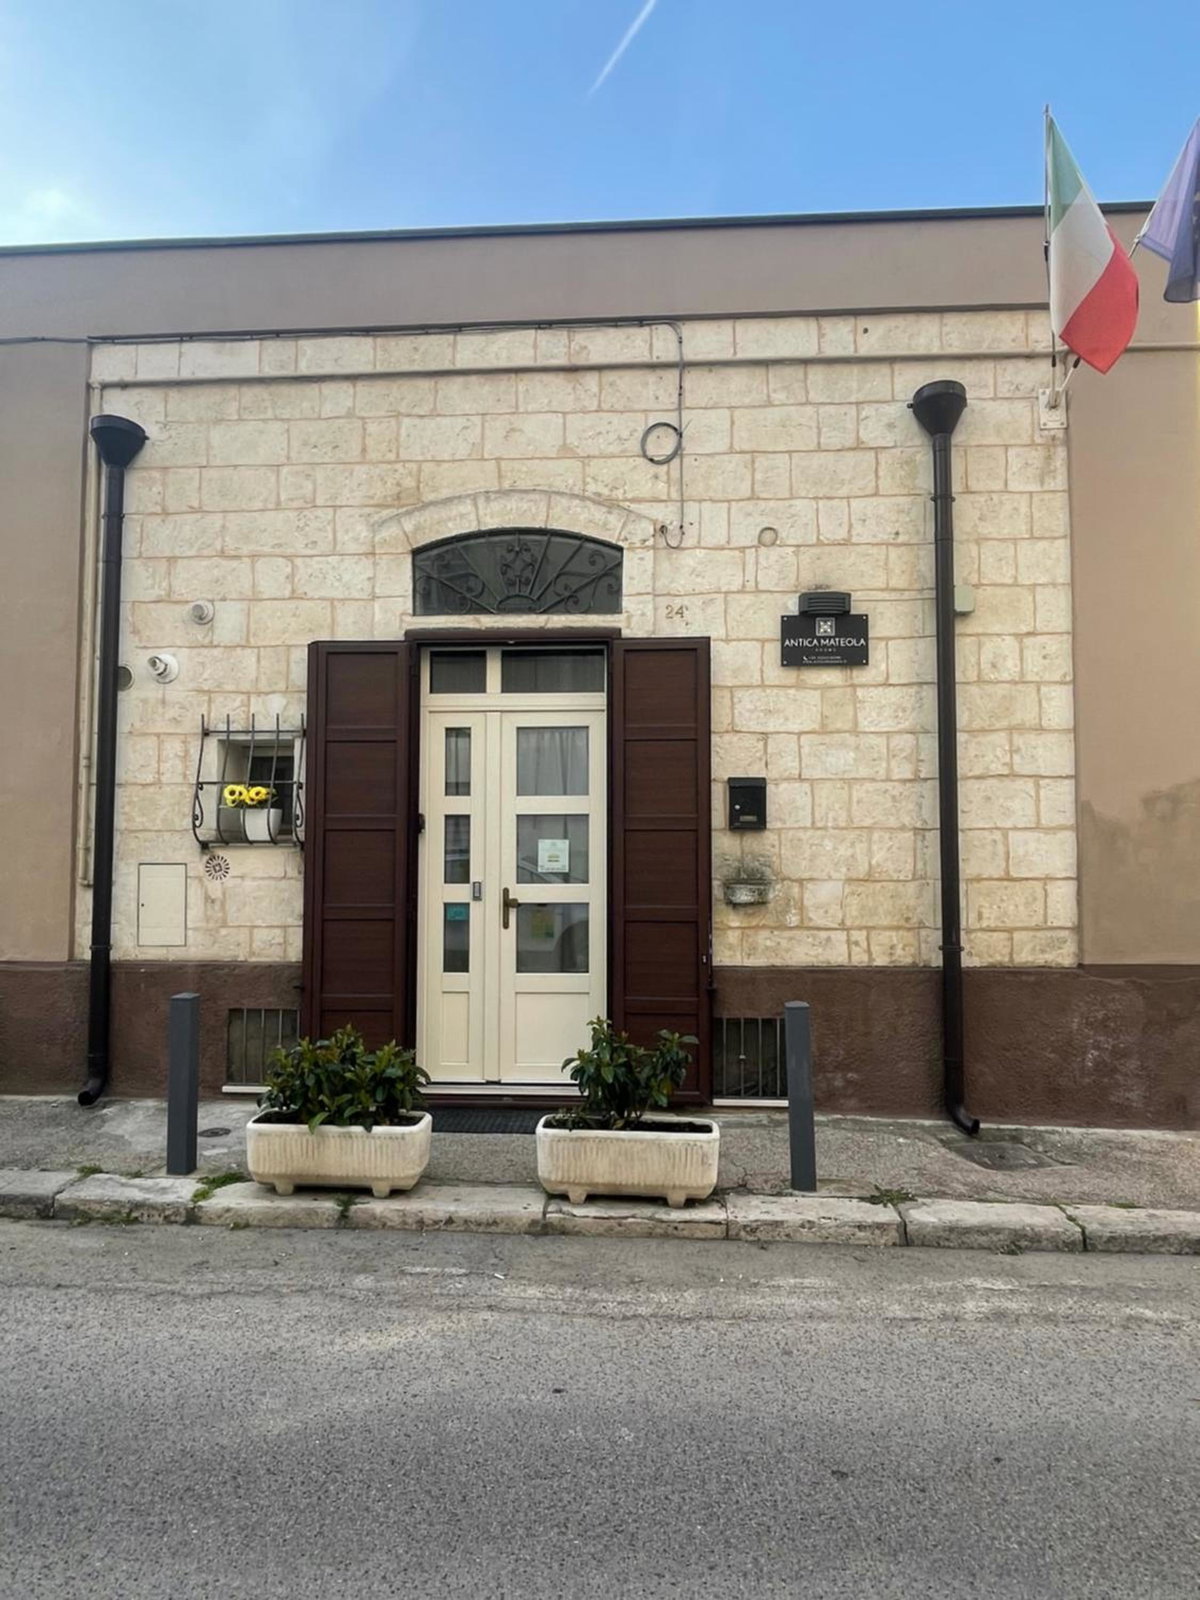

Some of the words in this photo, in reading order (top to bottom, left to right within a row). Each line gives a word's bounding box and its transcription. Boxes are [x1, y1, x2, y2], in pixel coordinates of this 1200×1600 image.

[665, 604, 684, 619] 24
[784, 638, 818, 647] ANTICA
[820, 637, 866, 647] MATEOLA
